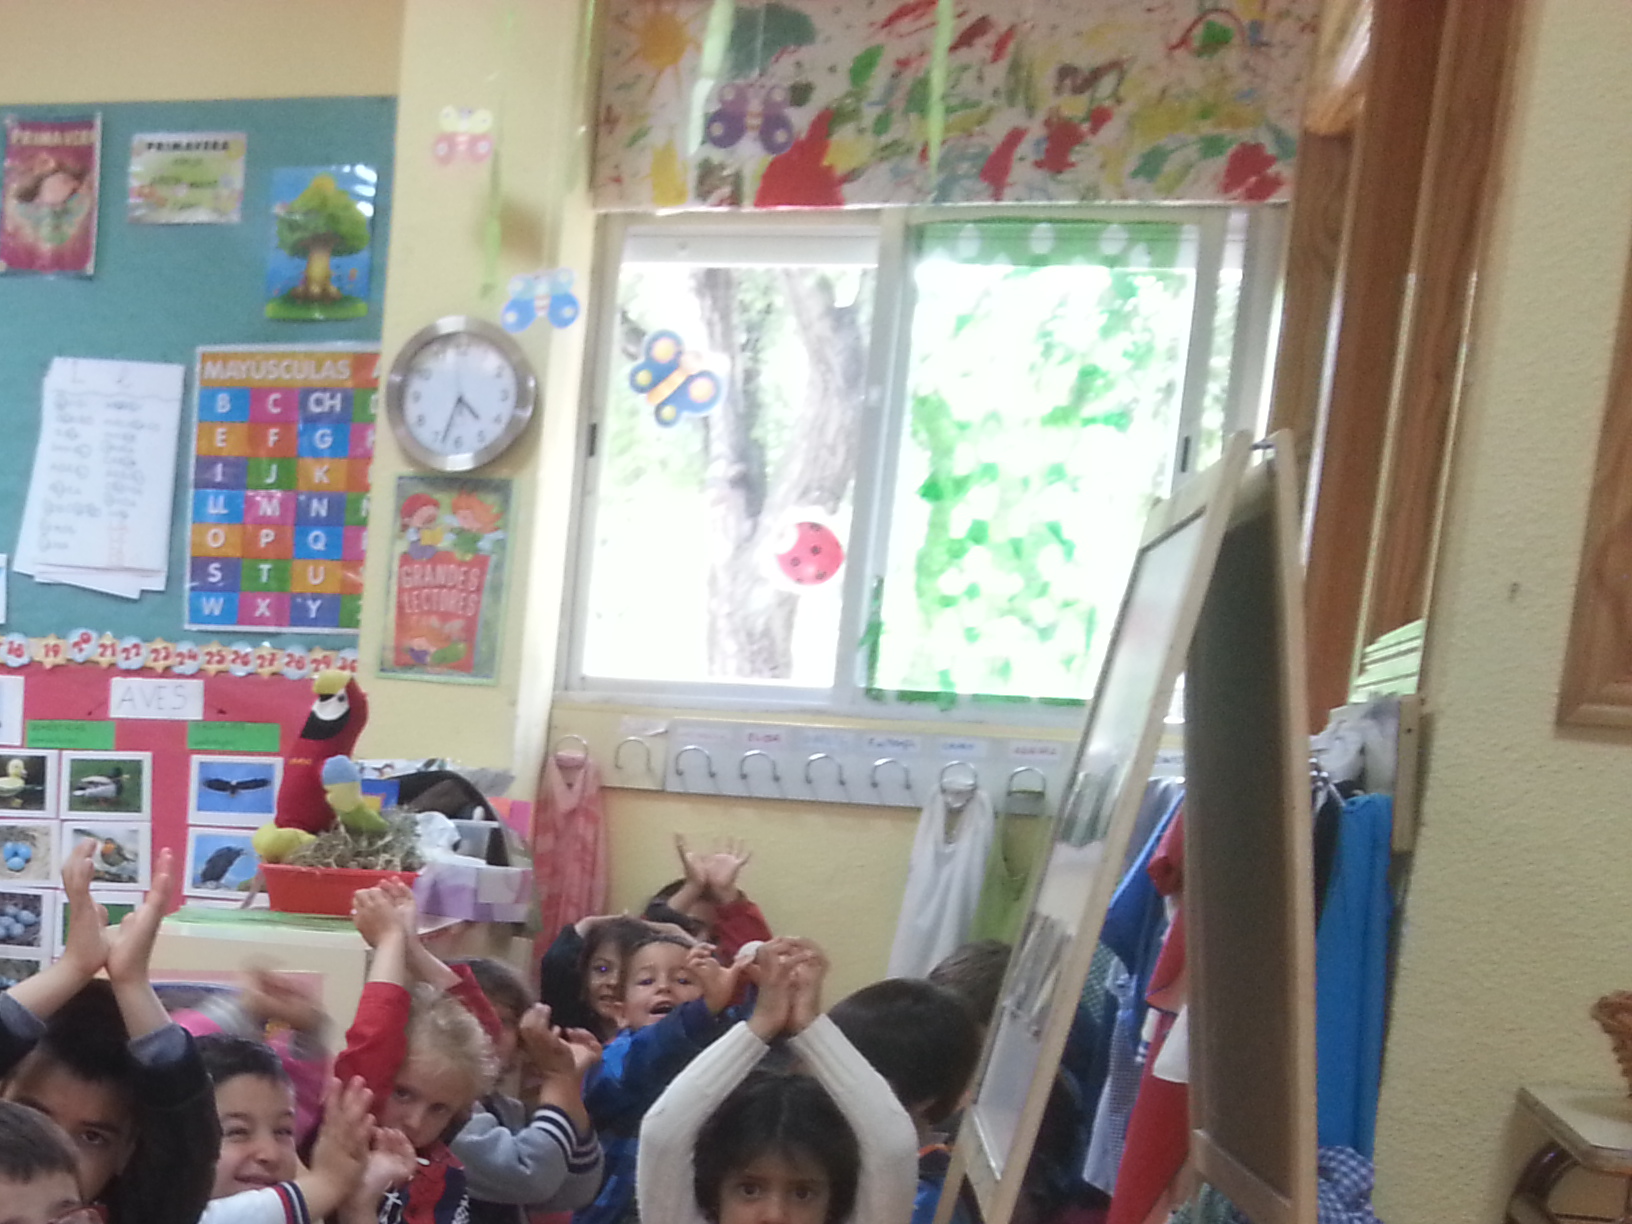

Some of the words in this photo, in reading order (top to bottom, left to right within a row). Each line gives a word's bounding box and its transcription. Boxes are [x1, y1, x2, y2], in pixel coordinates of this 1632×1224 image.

[216, 393, 231, 413] B
[267, 393, 282, 414] C
[308, 392, 343, 413] CH
[216, 428, 228, 448] E
[268, 428, 281, 448] F
[314, 429, 333, 449] G
[214, 463, 223, 482] I
[264, 464, 278, 484] J
[314, 464, 330, 484] K
[207, 495, 229, 515] LL
[259, 497, 281, 516] M
[310, 498, 329, 517] N
[207, 528, 226, 548] O
[259, 529, 275, 548] P
[307, 530, 327, 551] Q
[207, 563, 222, 582] S
[258, 564, 272, 583] T
[307, 566, 325, 585] U
[400, 564, 481, 591] GRANDES
[202, 596, 224, 616] W
[254, 598, 271, 617] X
[306, 599, 322, 618] Y
[403, 588, 479, 617] LECTORES
[43, 643, 60, 658] 19
[98, 642, 116, 657] 21
[121, 643, 141, 661] 22
[175, 650, 198, 666] 24
[205, 649, 226, 665] 25
[231, 650, 251, 666] 26
[256, 652, 276, 668] 27
[120, 683, 188, 711] AVES
